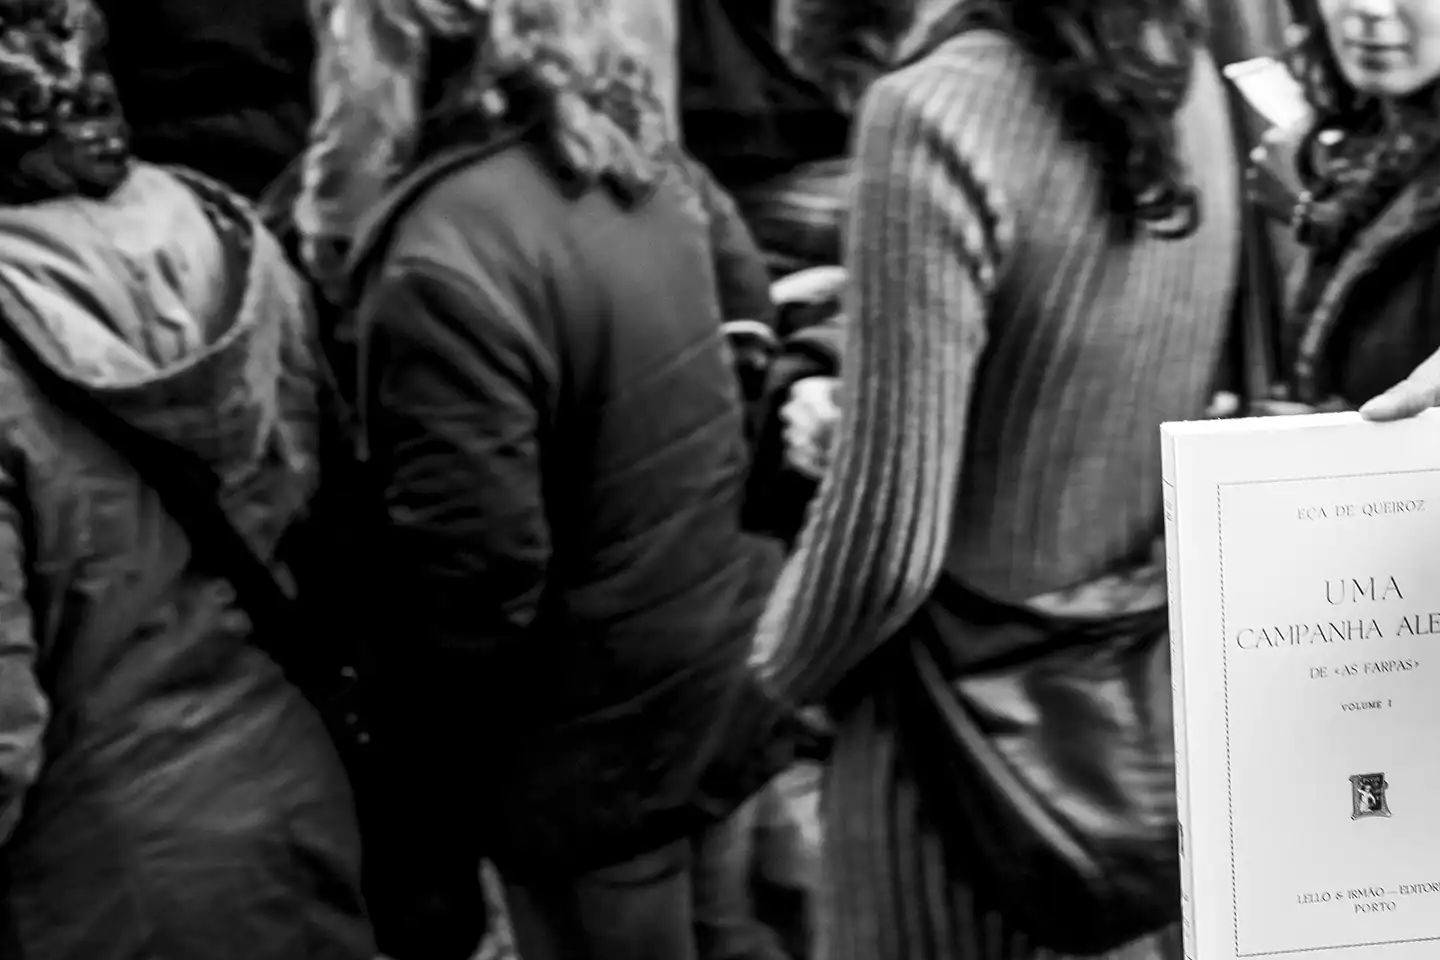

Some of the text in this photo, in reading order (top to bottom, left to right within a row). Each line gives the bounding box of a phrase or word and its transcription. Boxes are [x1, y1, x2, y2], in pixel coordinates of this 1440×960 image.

[1335, 503, 1356, 517] DE
[1361, 499, 1426, 517] QUEIROZ
[1325, 575, 1404, 605] UMA
[1236, 618, 1383, 650] CAMPANHA
[1310, 666, 1328, 680] DE
[1341, 700, 1382, 712] VOLUME
[1297, 891, 1331, 904] LELLO
[1335, 891, 1344, 900] &
[1353, 900, 1397, 914] PORTO
